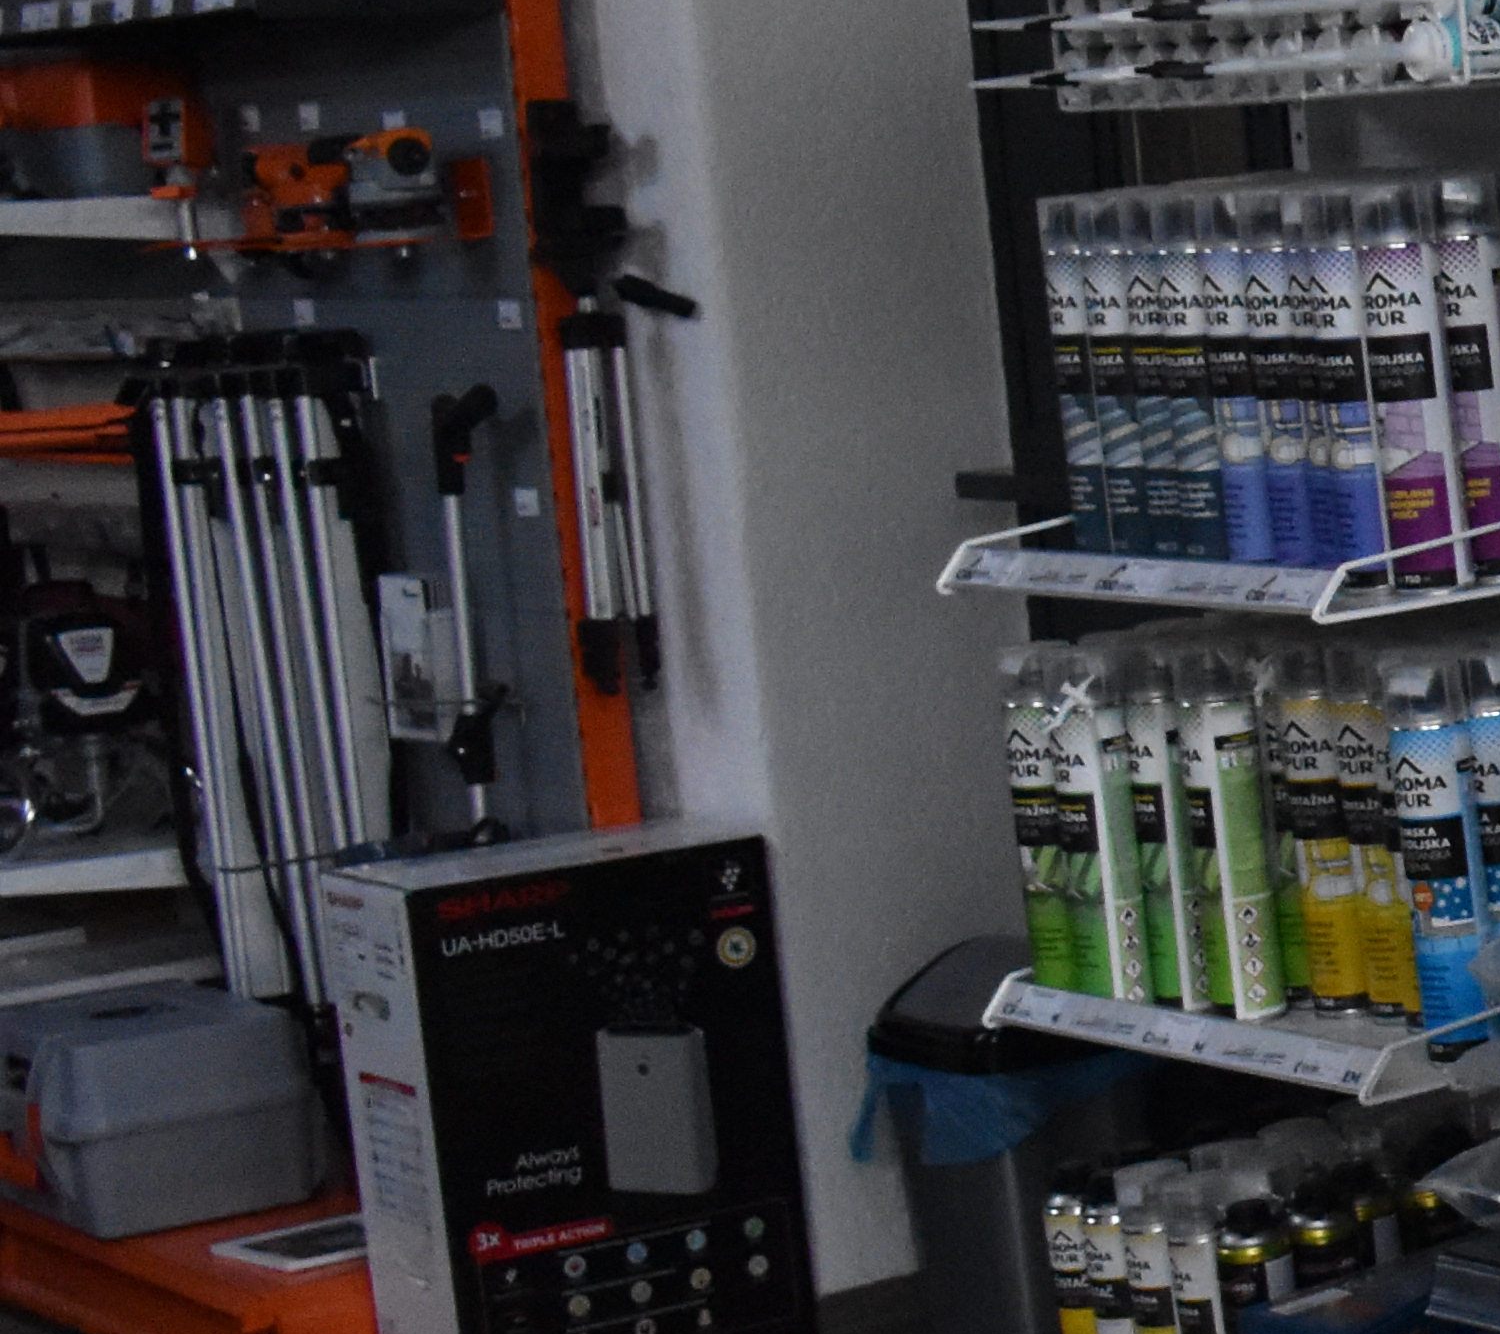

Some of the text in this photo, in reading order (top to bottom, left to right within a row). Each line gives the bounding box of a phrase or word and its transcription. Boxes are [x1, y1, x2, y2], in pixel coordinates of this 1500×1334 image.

[1366, 311, 1406, 326] PUR
[515, 1145, 580, 1171] Always
[486, 1165, 583, 1198] Protecting
[513, 1232, 556, 1252] TRIPLE
[557, 1222, 606, 1242] ACTION
